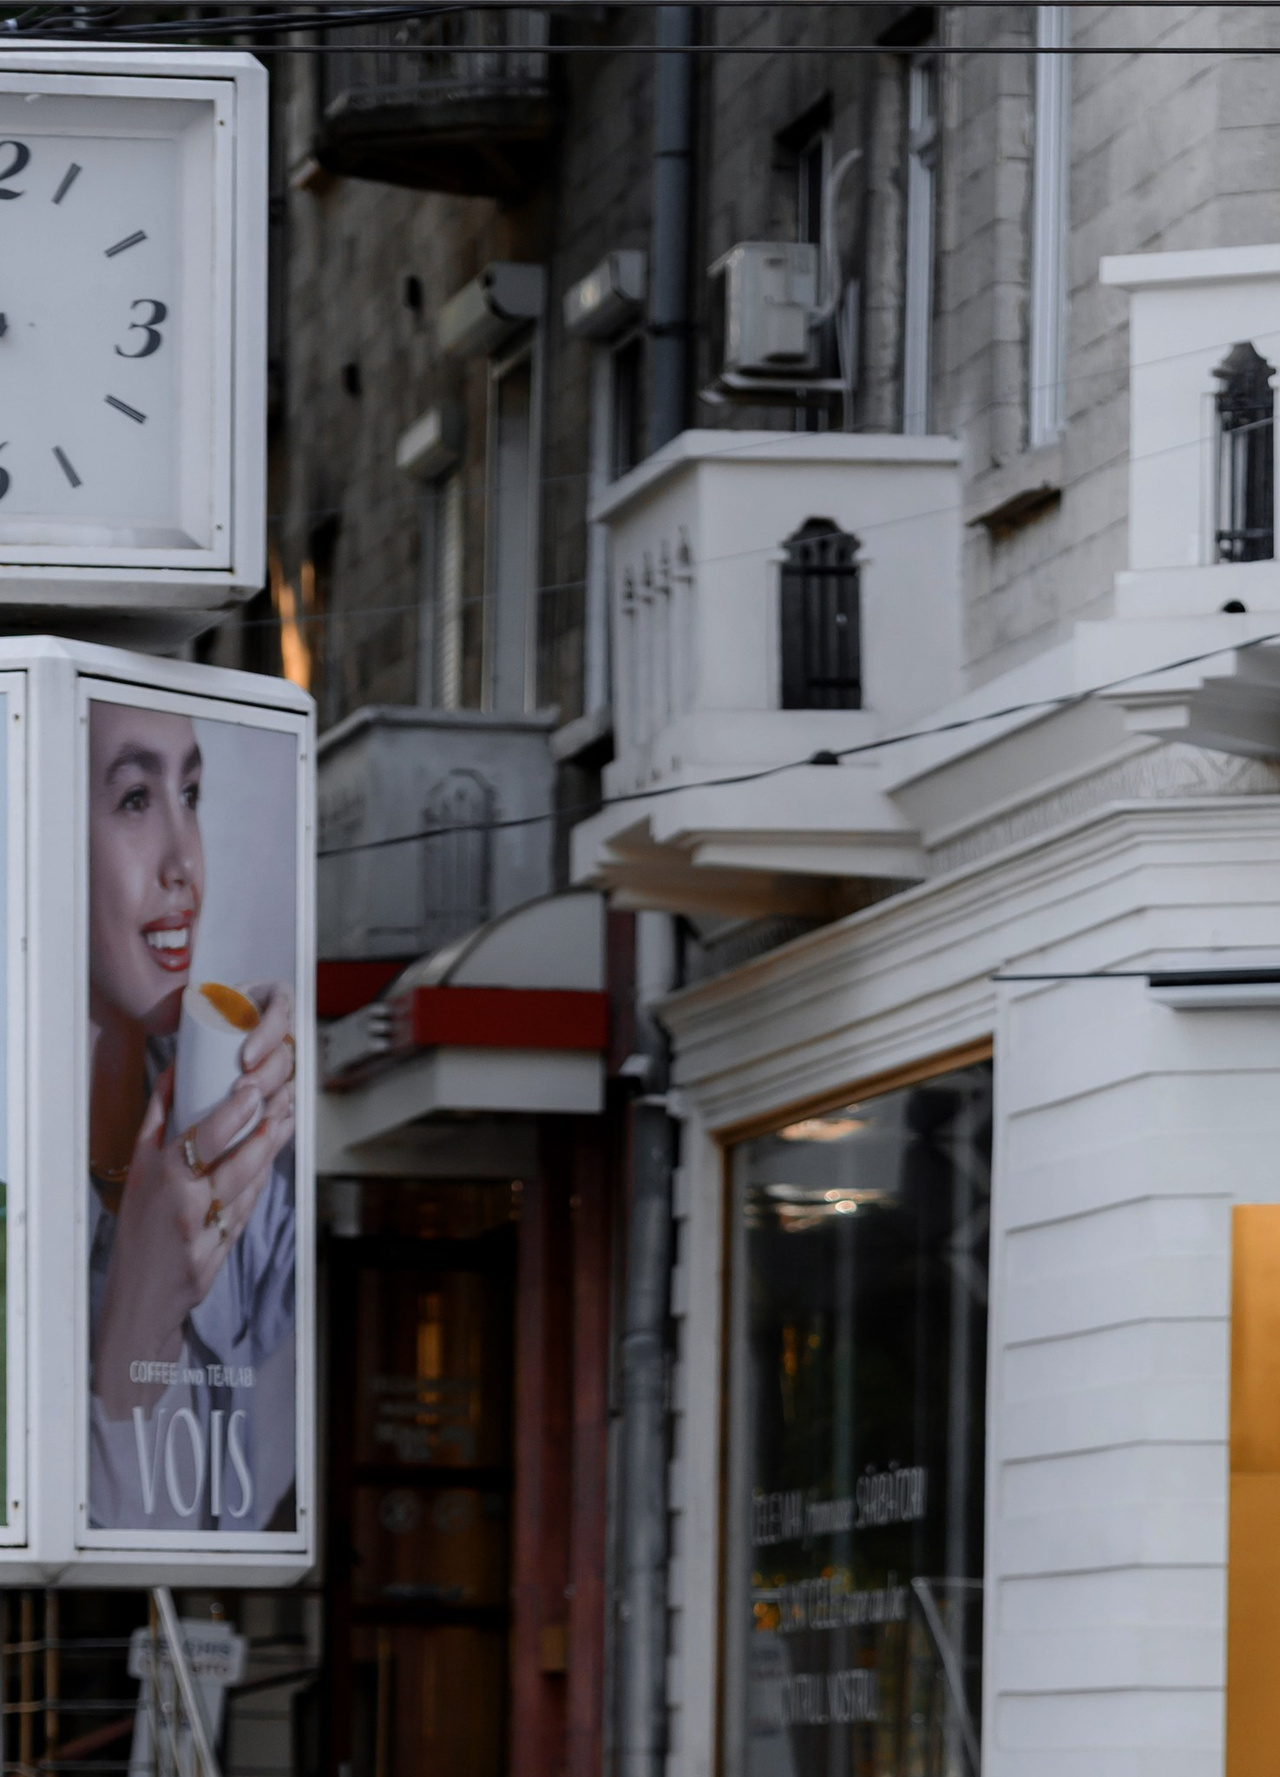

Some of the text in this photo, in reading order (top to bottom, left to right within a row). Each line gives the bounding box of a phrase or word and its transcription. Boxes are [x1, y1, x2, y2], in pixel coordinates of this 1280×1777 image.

[0, 140, 30, 200] 2
[114, 298, 167, 358] 3
[129, 1359, 179, 1385] COFFEE
[132, 1405, 252, 1518] VOIS
